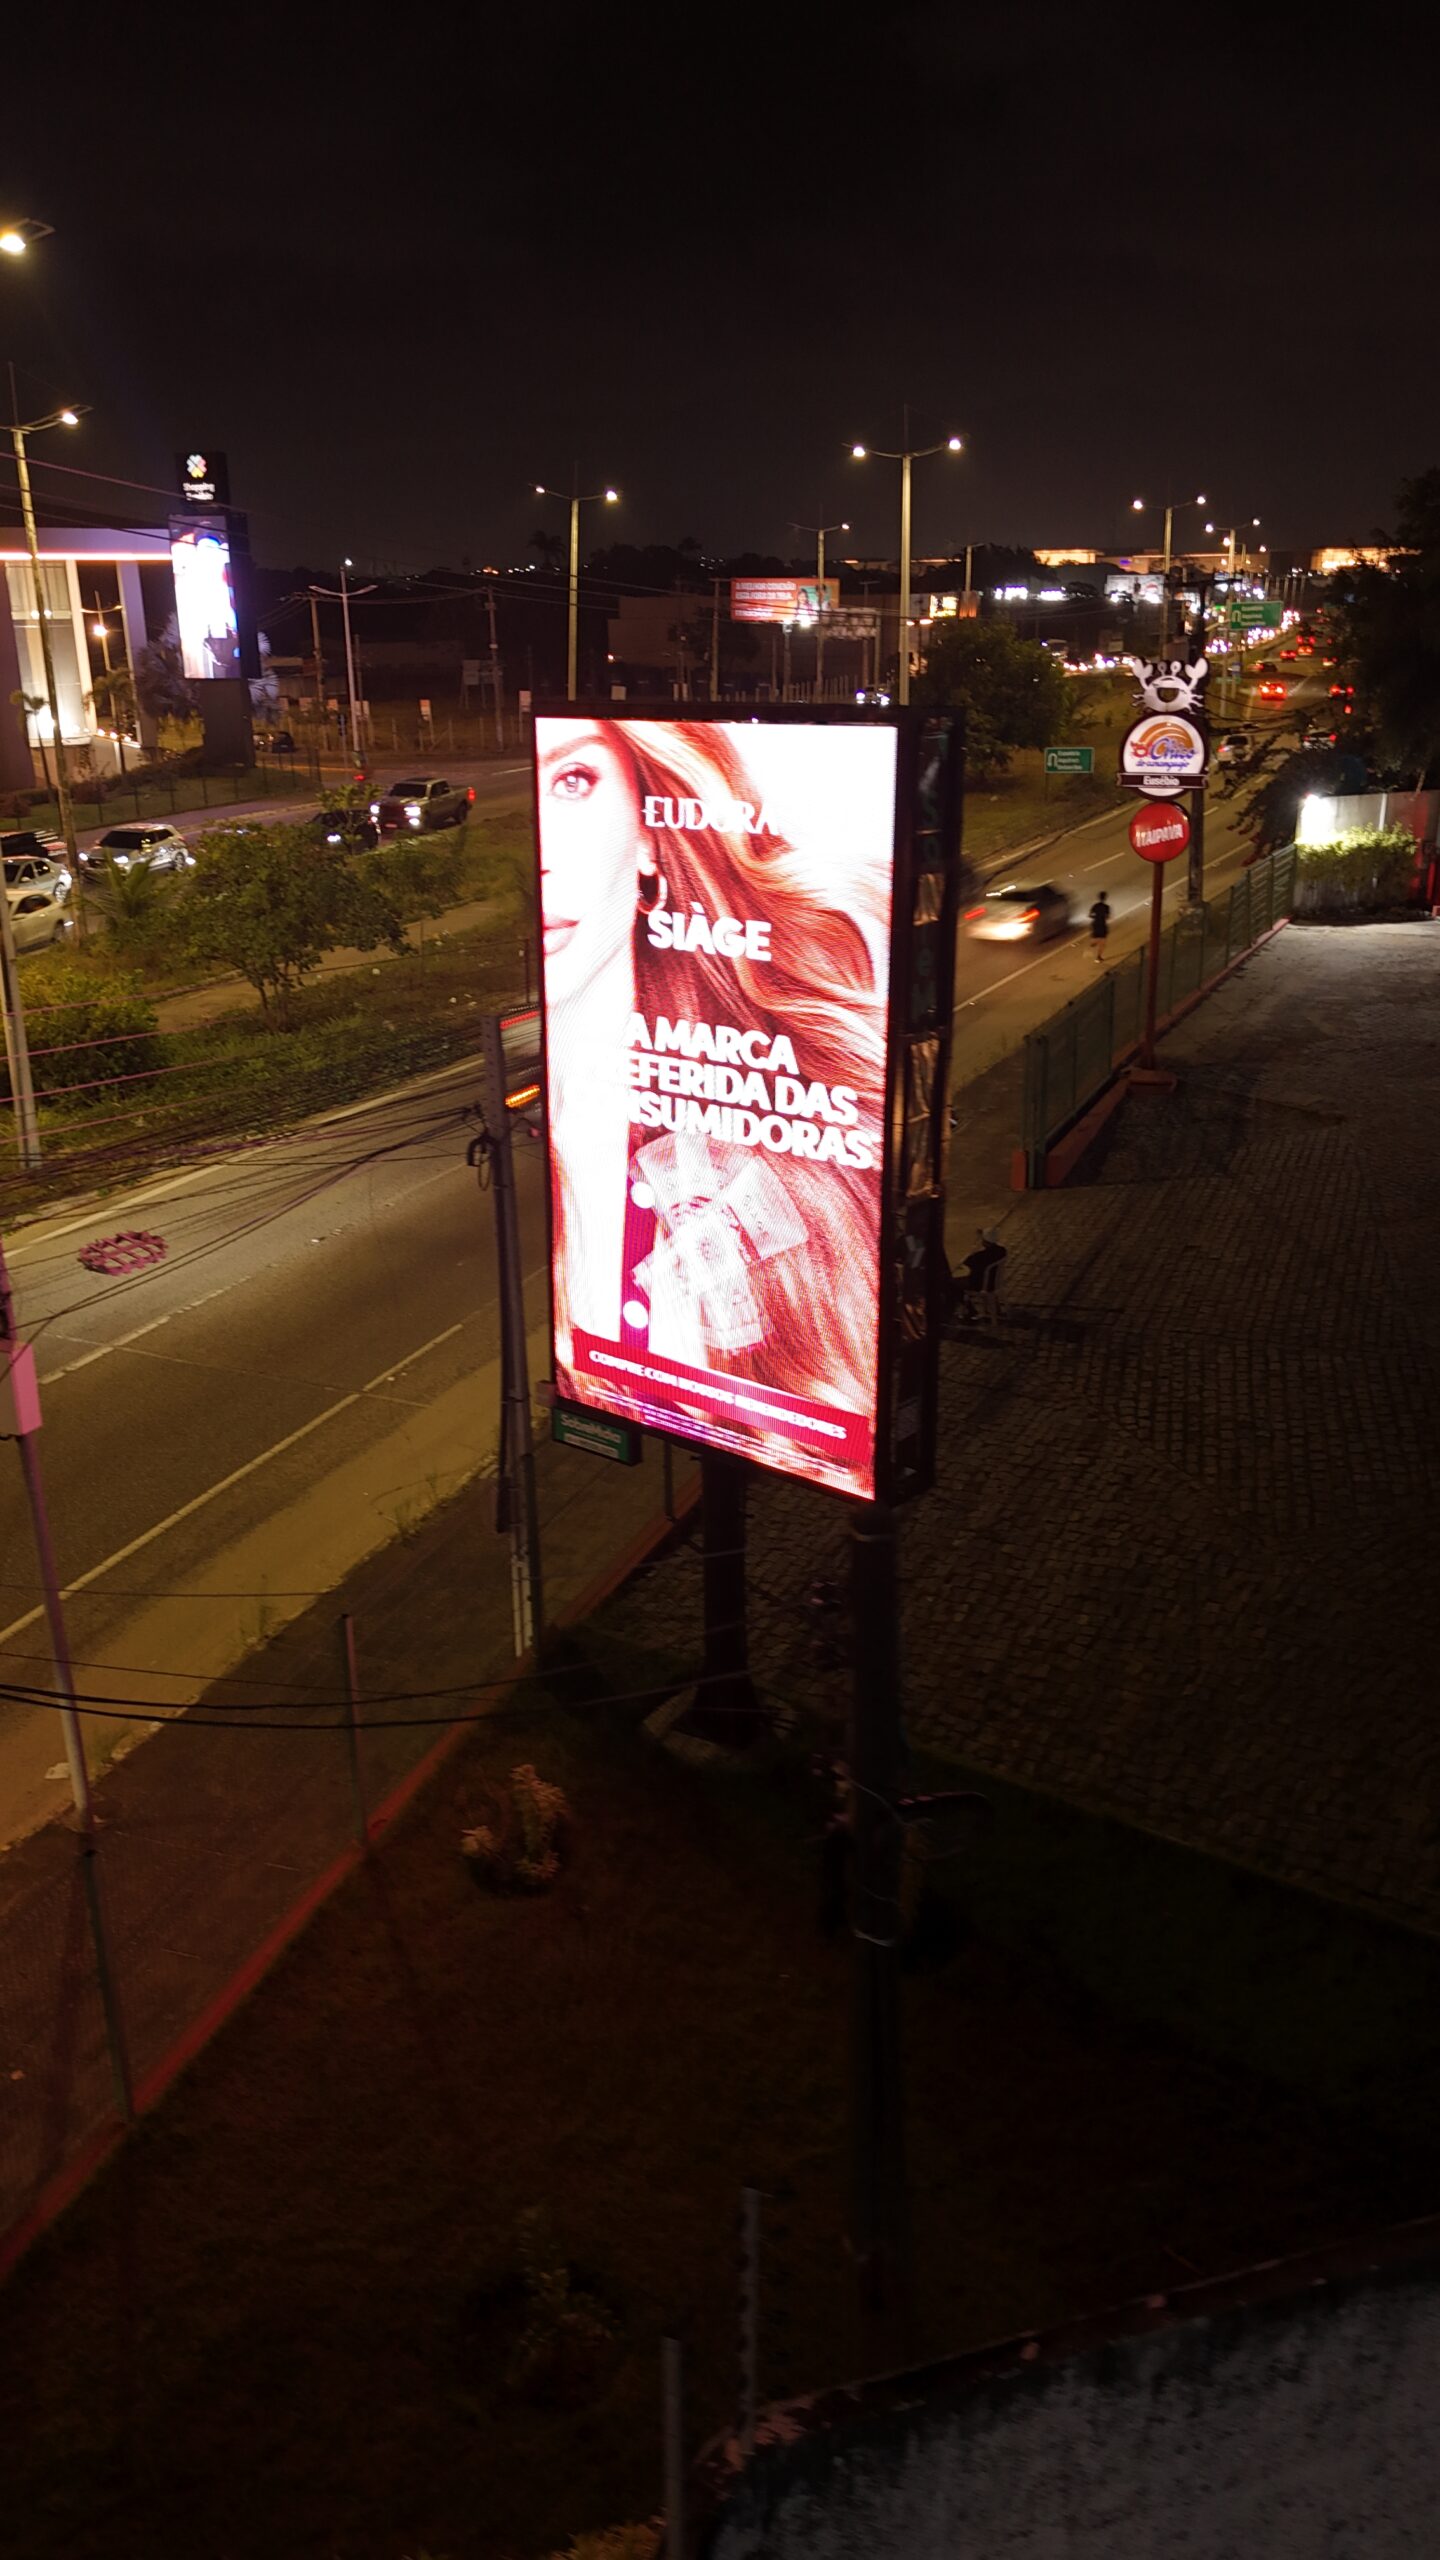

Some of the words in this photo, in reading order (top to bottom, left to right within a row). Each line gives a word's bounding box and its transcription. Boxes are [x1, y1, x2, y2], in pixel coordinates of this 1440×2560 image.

[641, 796, 779, 836] EUDORA
[647, 901, 773, 962] SIÀGE
[626, 1012, 654, 1050] A
[654, 1015, 800, 1075] MARCA
[626, 1054, 773, 1111] EFERIDA
[774, 1075, 859, 1125] DAS
